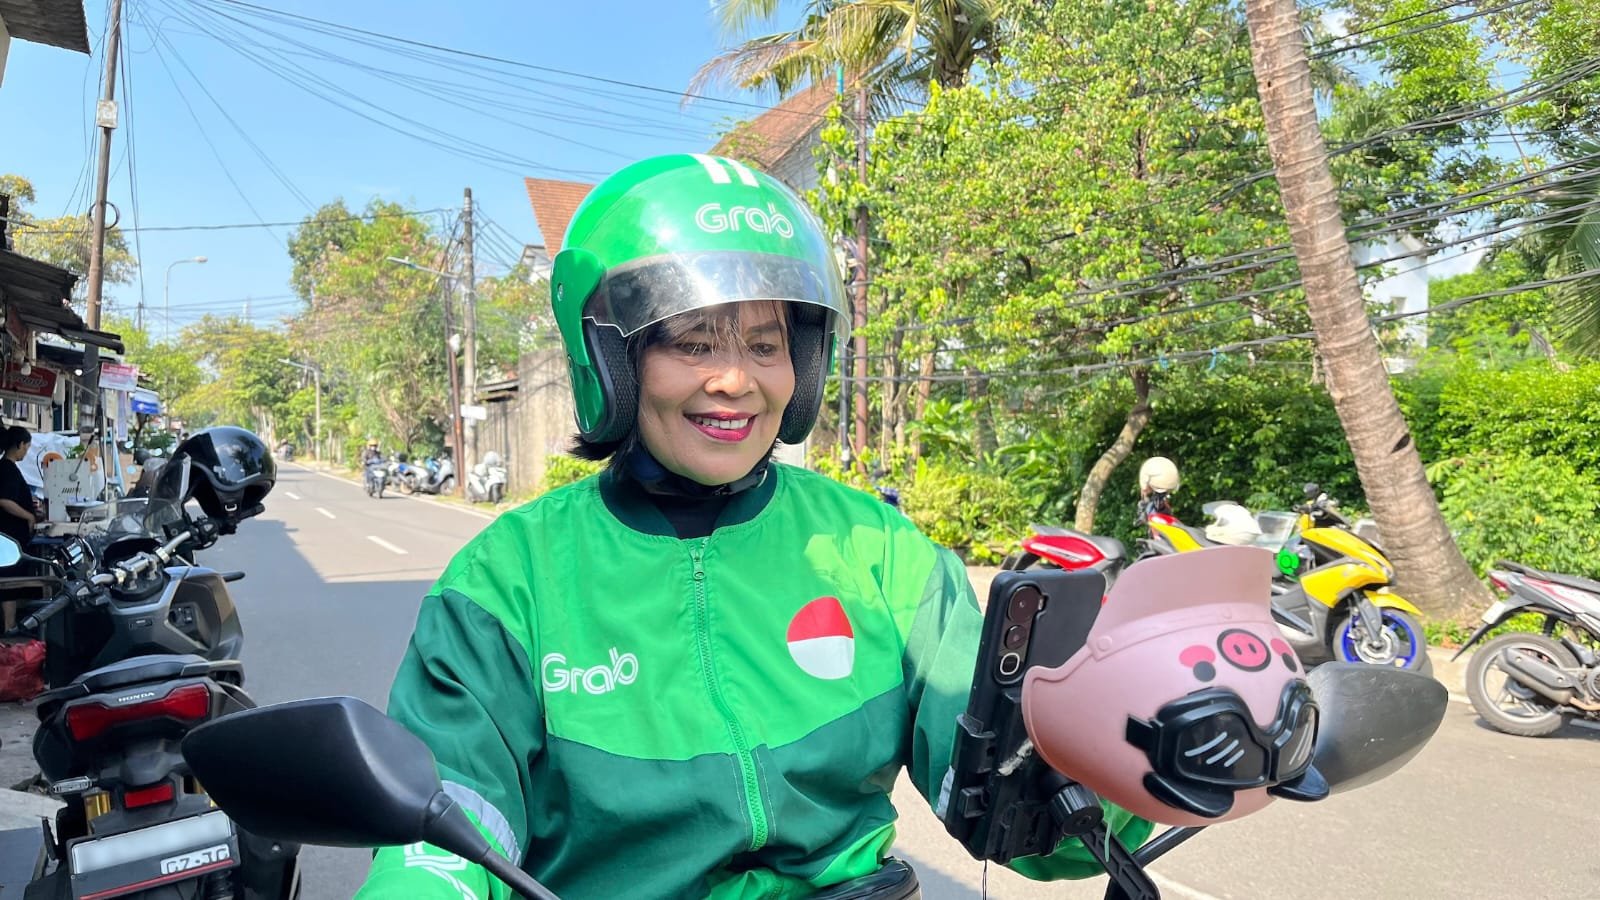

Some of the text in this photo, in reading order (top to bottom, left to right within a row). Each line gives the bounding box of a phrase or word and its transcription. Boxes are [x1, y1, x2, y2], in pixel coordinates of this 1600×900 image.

[695, 201, 794, 238] Grab
[541, 646, 639, 695] Grab
[117, 691, 155, 702] HONDA
